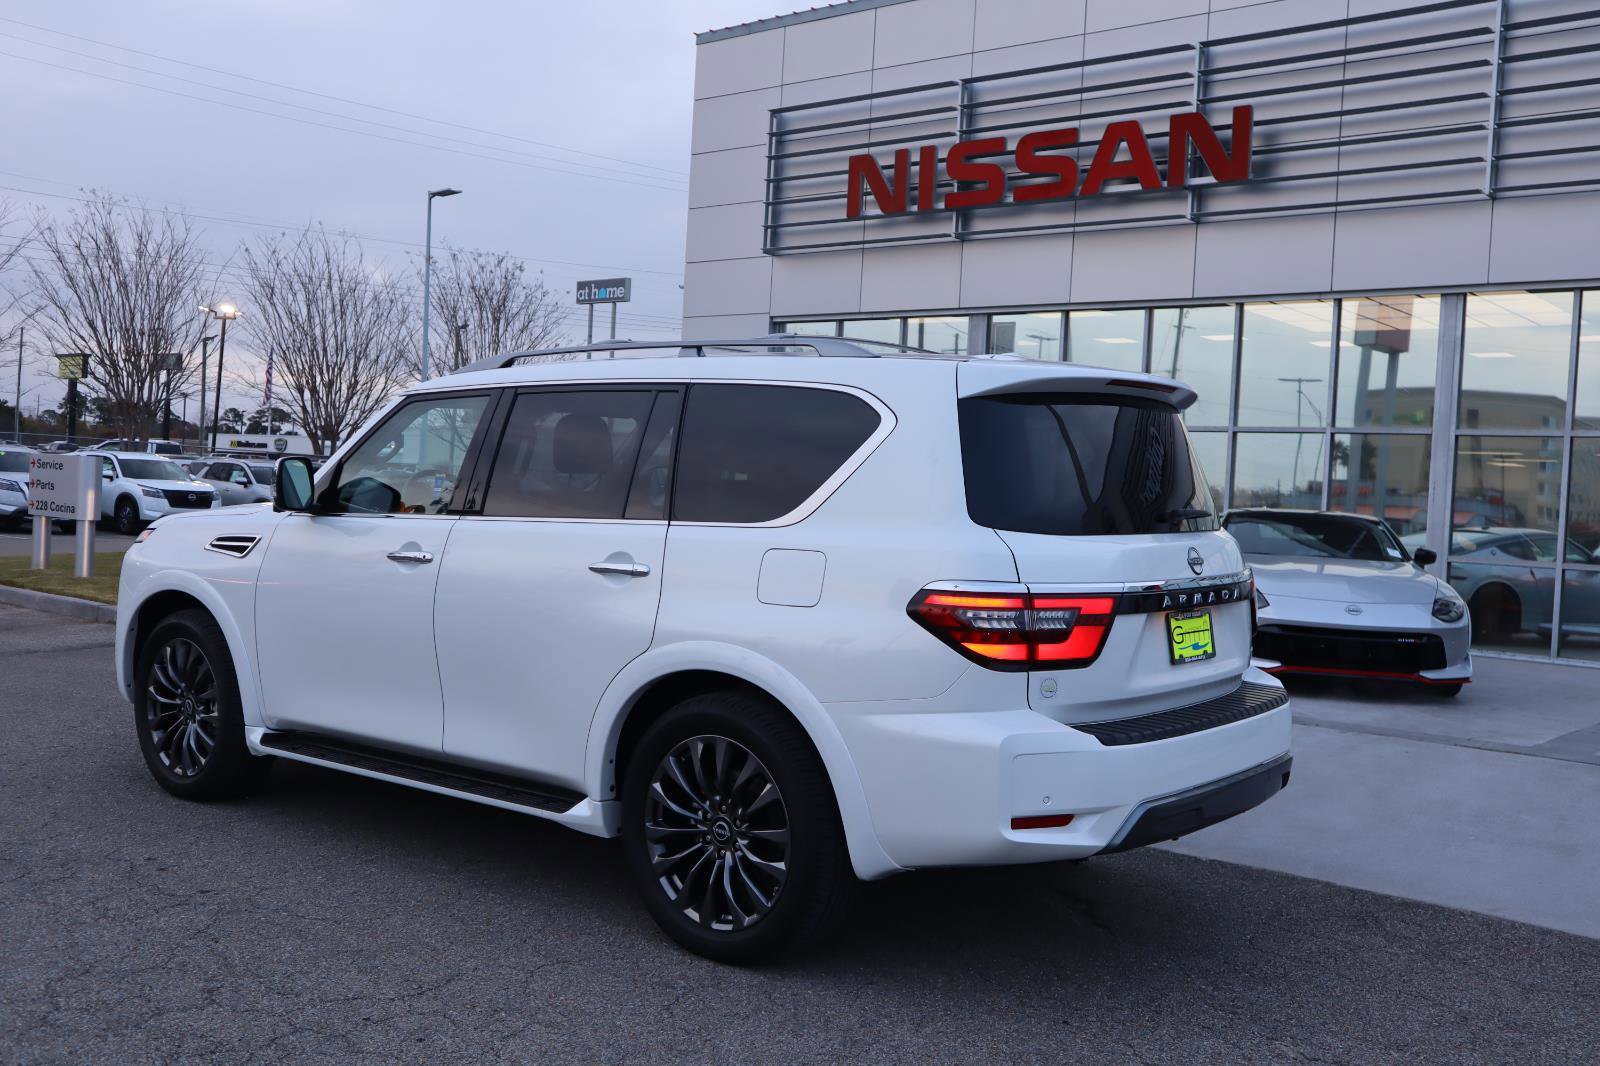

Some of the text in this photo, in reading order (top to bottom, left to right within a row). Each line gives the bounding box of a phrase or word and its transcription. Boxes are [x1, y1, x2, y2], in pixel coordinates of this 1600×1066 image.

[846, 104, 1254, 219] NISSAN
[577, 283, 625, 300] at home
[36, 458, 64, 471] Service
[35, 480, 55, 491] Parts
[35, 501, 76, 514] 228 Cocina
[1163, 590, 1240, 609] ARMADA
